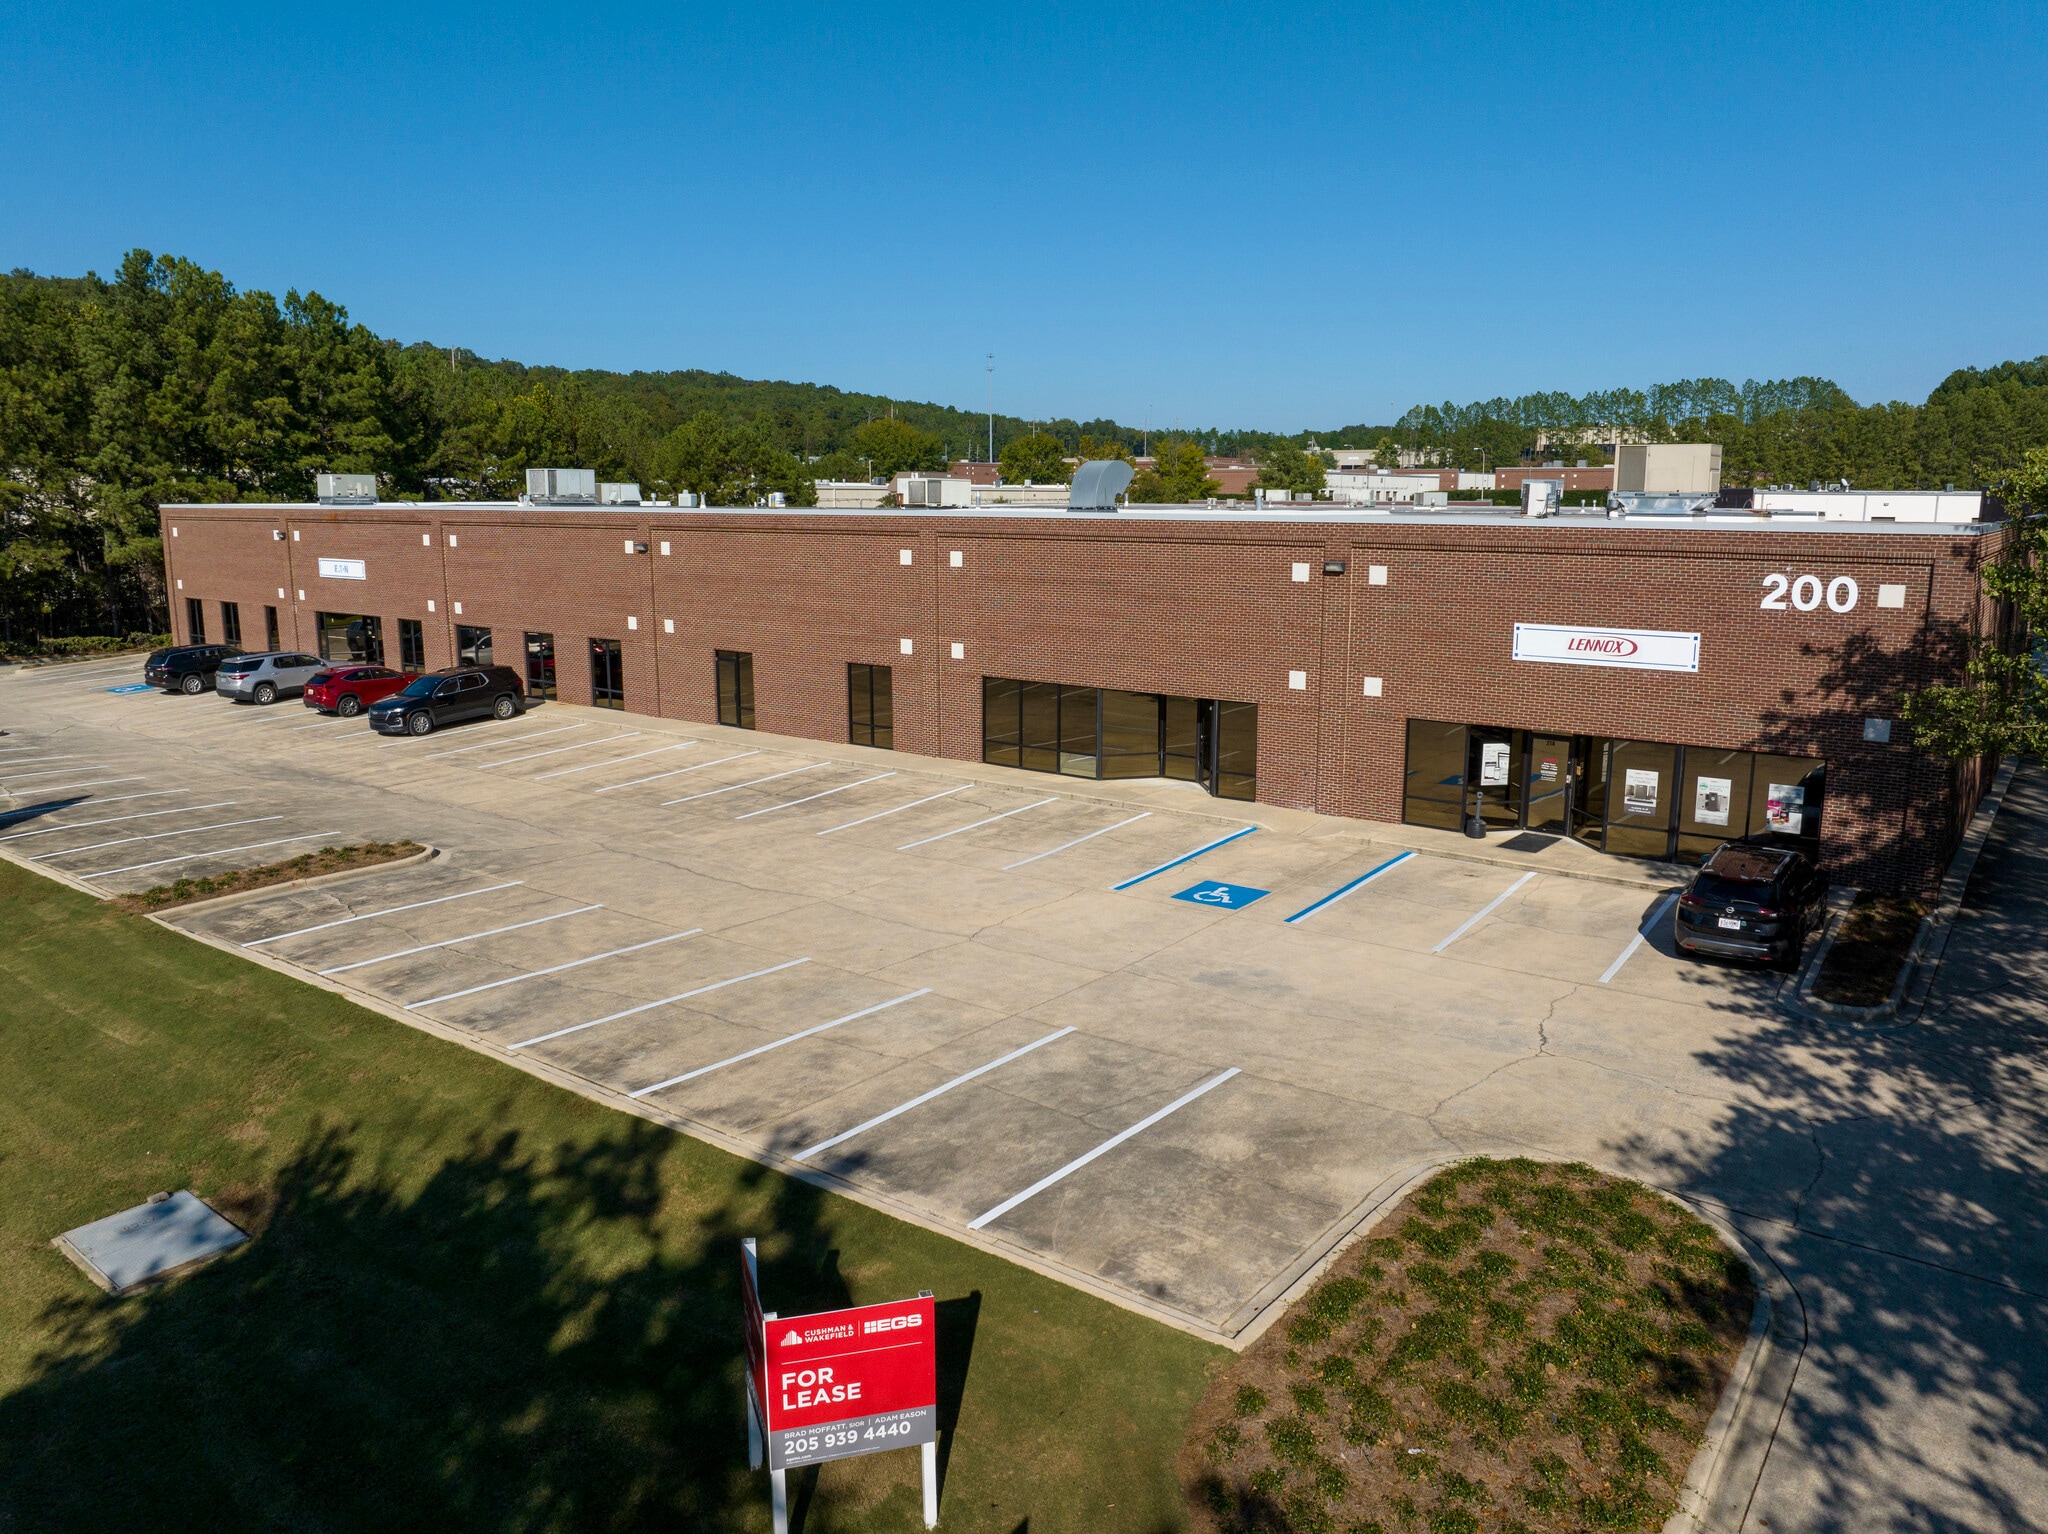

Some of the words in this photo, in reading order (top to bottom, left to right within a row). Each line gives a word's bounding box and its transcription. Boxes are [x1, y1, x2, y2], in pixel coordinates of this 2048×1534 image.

[1759, 573, 1859, 613] 200
[1567, 637, 1625, 654] LENNOX
[804, 1325, 846, 1337] CUSHMAN
[877, 1314, 922, 1332] EGS
[804, 1330, 854, 1343] WAKEFIELD
[782, 1367, 834, 1390] FOR
[782, 1382, 861, 1411] LEASE
[784, 1430, 807, 1439] BRAD
[808, 1423, 848, 1435] MOFFATT,
[875, 1414, 898, 1424] ADAM
[900, 1409, 927, 1420] EASON
[784, 1436, 819, 1455] 205
[824, 1429, 858, 1448] 939
[863, 1421, 911, 1440] 4440
